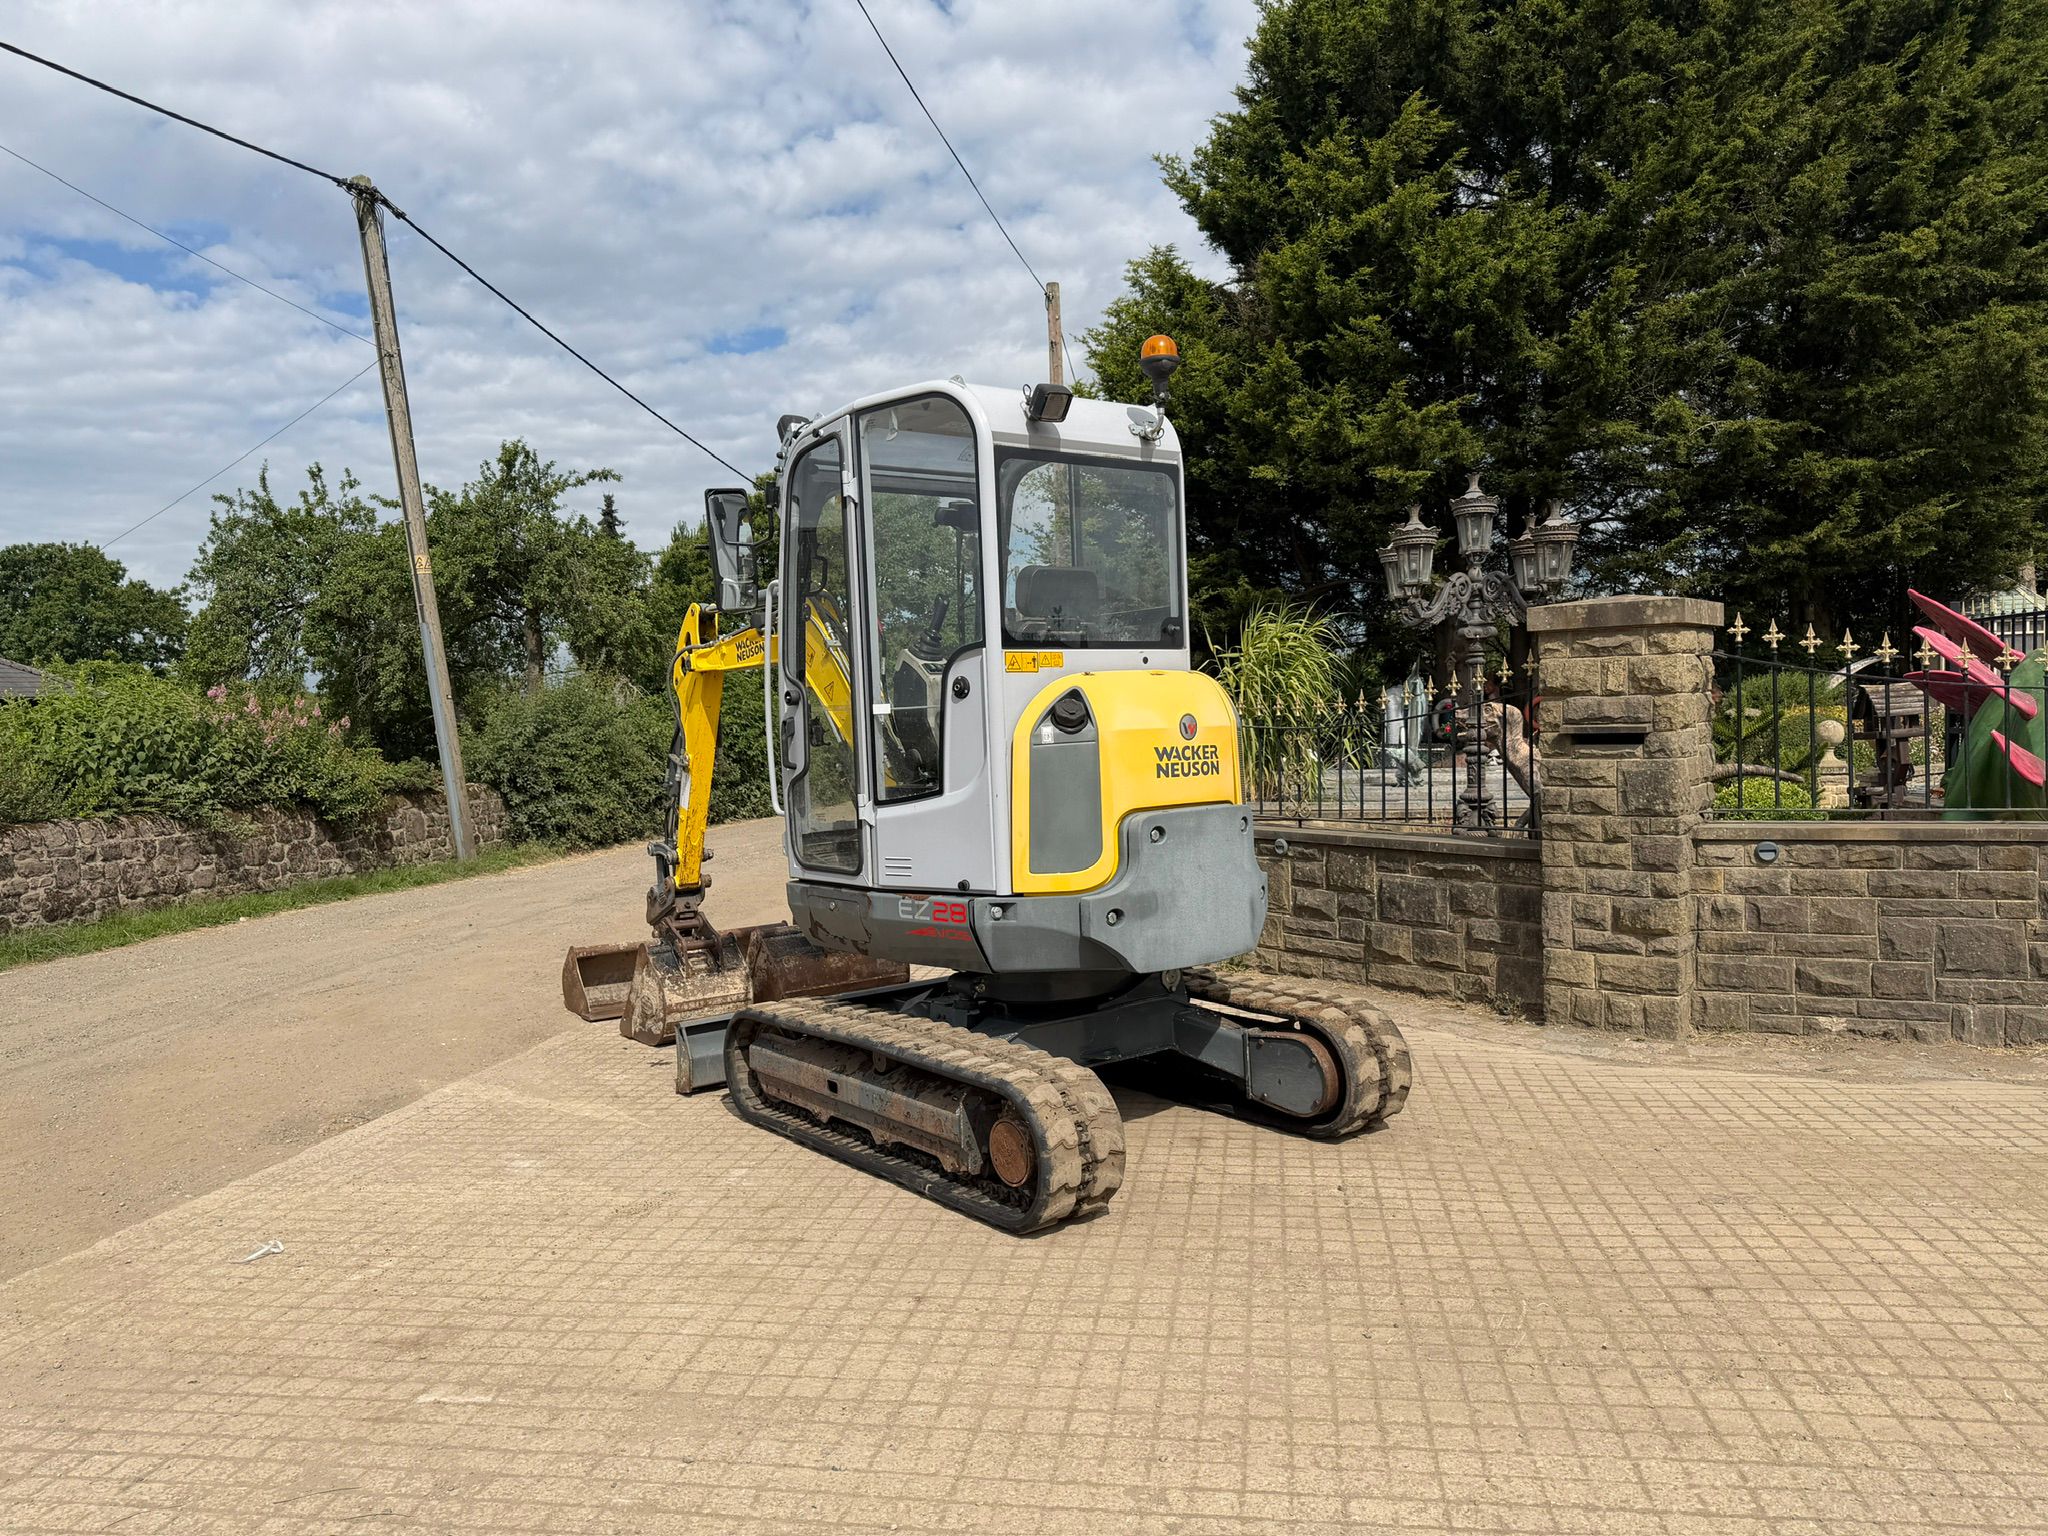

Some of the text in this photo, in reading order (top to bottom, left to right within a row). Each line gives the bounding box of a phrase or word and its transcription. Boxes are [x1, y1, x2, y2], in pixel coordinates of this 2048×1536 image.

[736, 642, 765, 662] NEUSON
[1153, 744, 1219, 762] WACKER
[1156, 760, 1220, 778] NEUSON
[898, 898, 968, 923] EZ28
